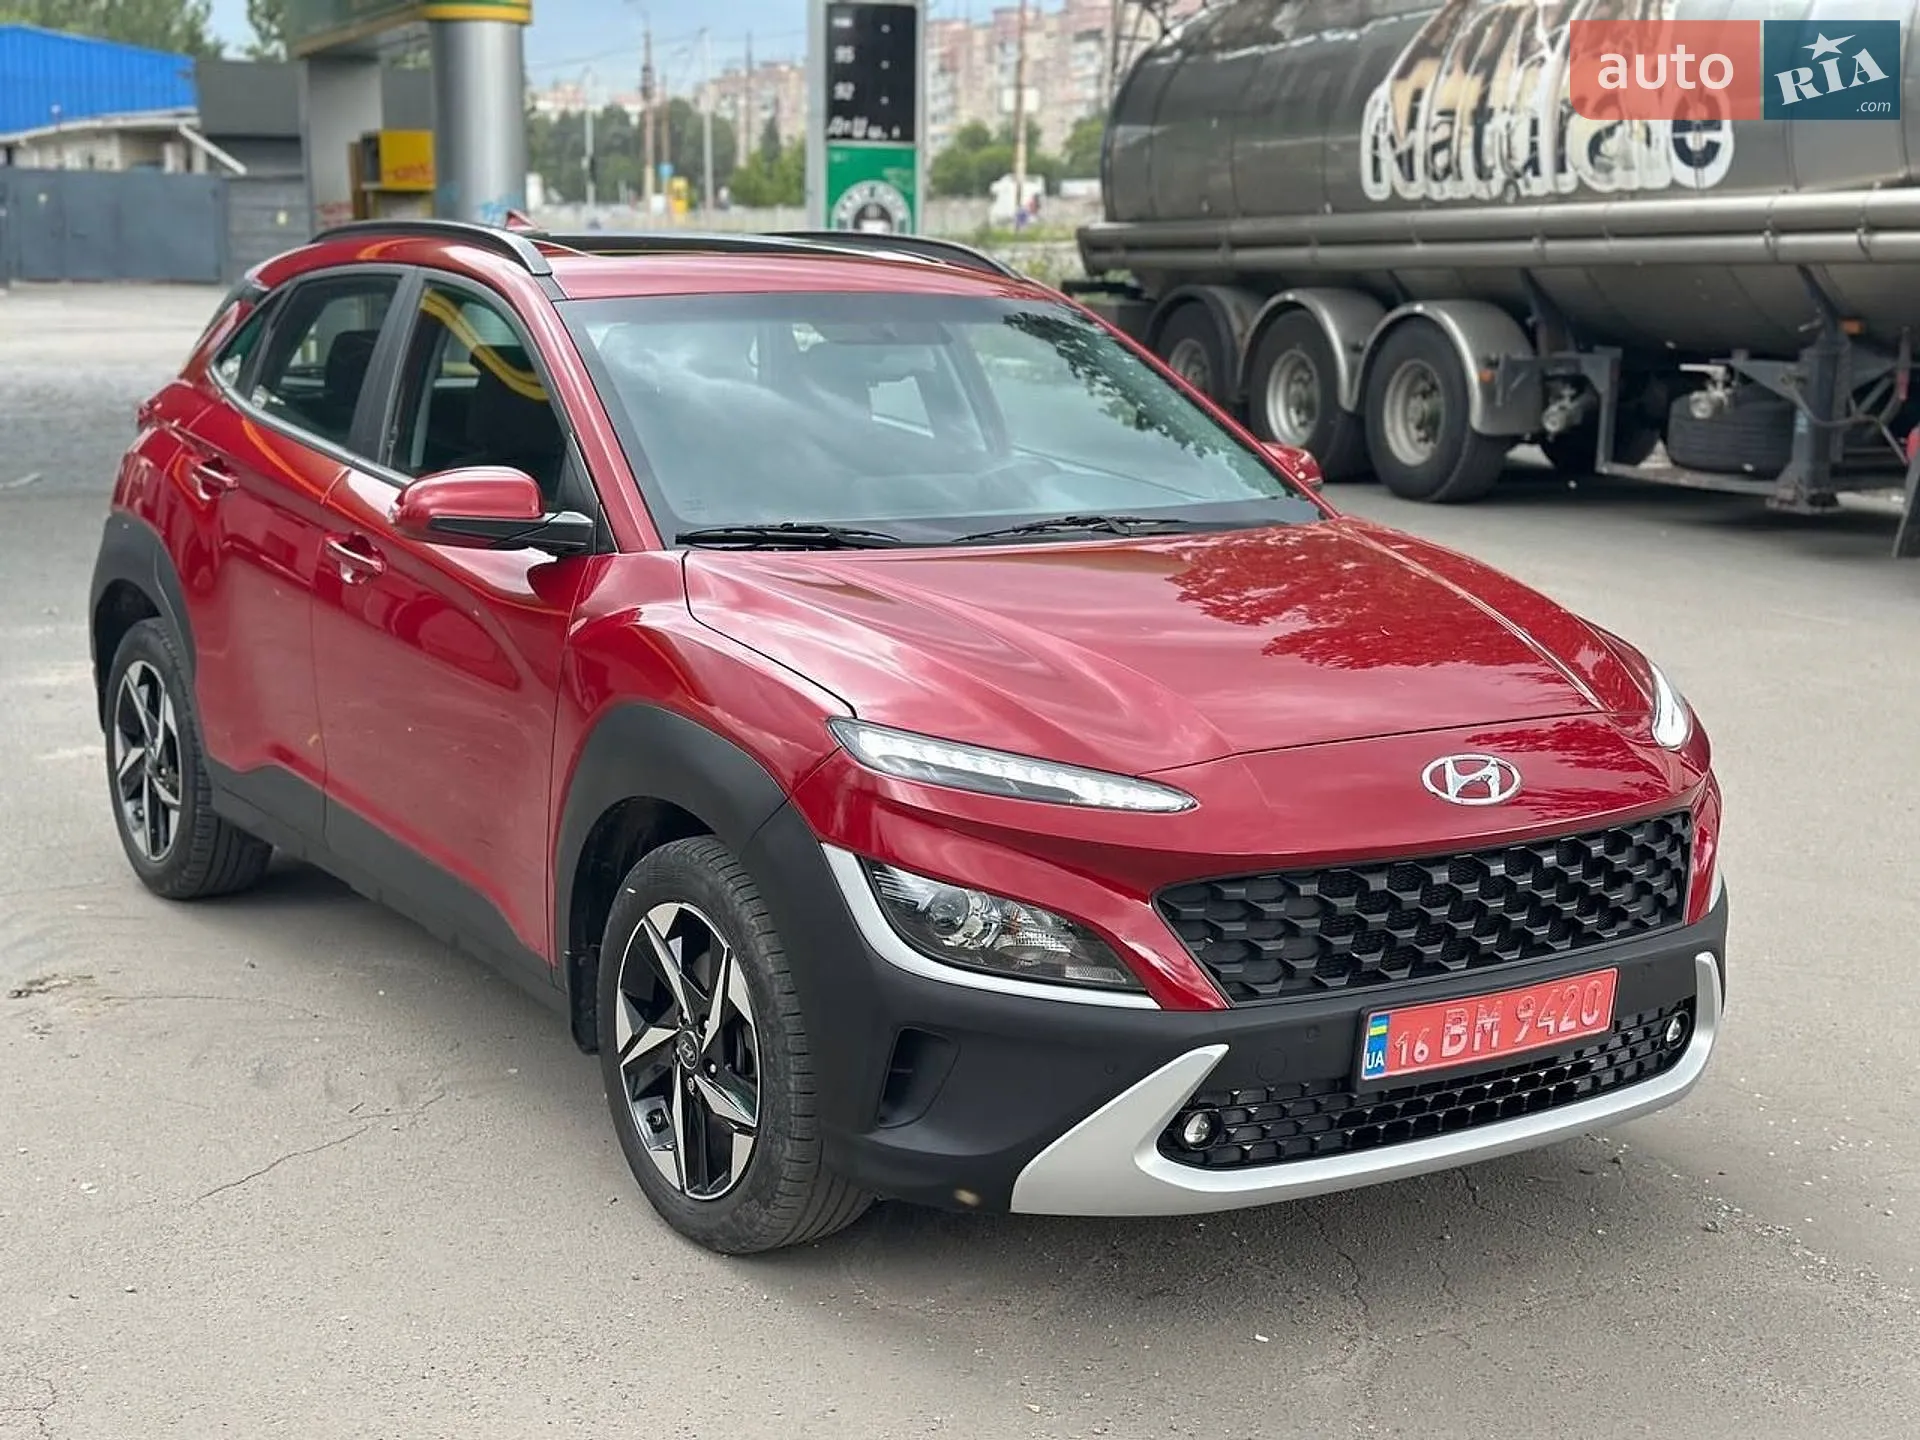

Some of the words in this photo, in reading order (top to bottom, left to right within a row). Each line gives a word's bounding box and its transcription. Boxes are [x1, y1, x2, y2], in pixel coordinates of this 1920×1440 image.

[1394, 1028, 1430, 1066] 16
[1441, 1000, 1503, 1058] BM
[1514, 980, 1602, 1044] 9420
[1366, 1053, 1385, 1070] UA
